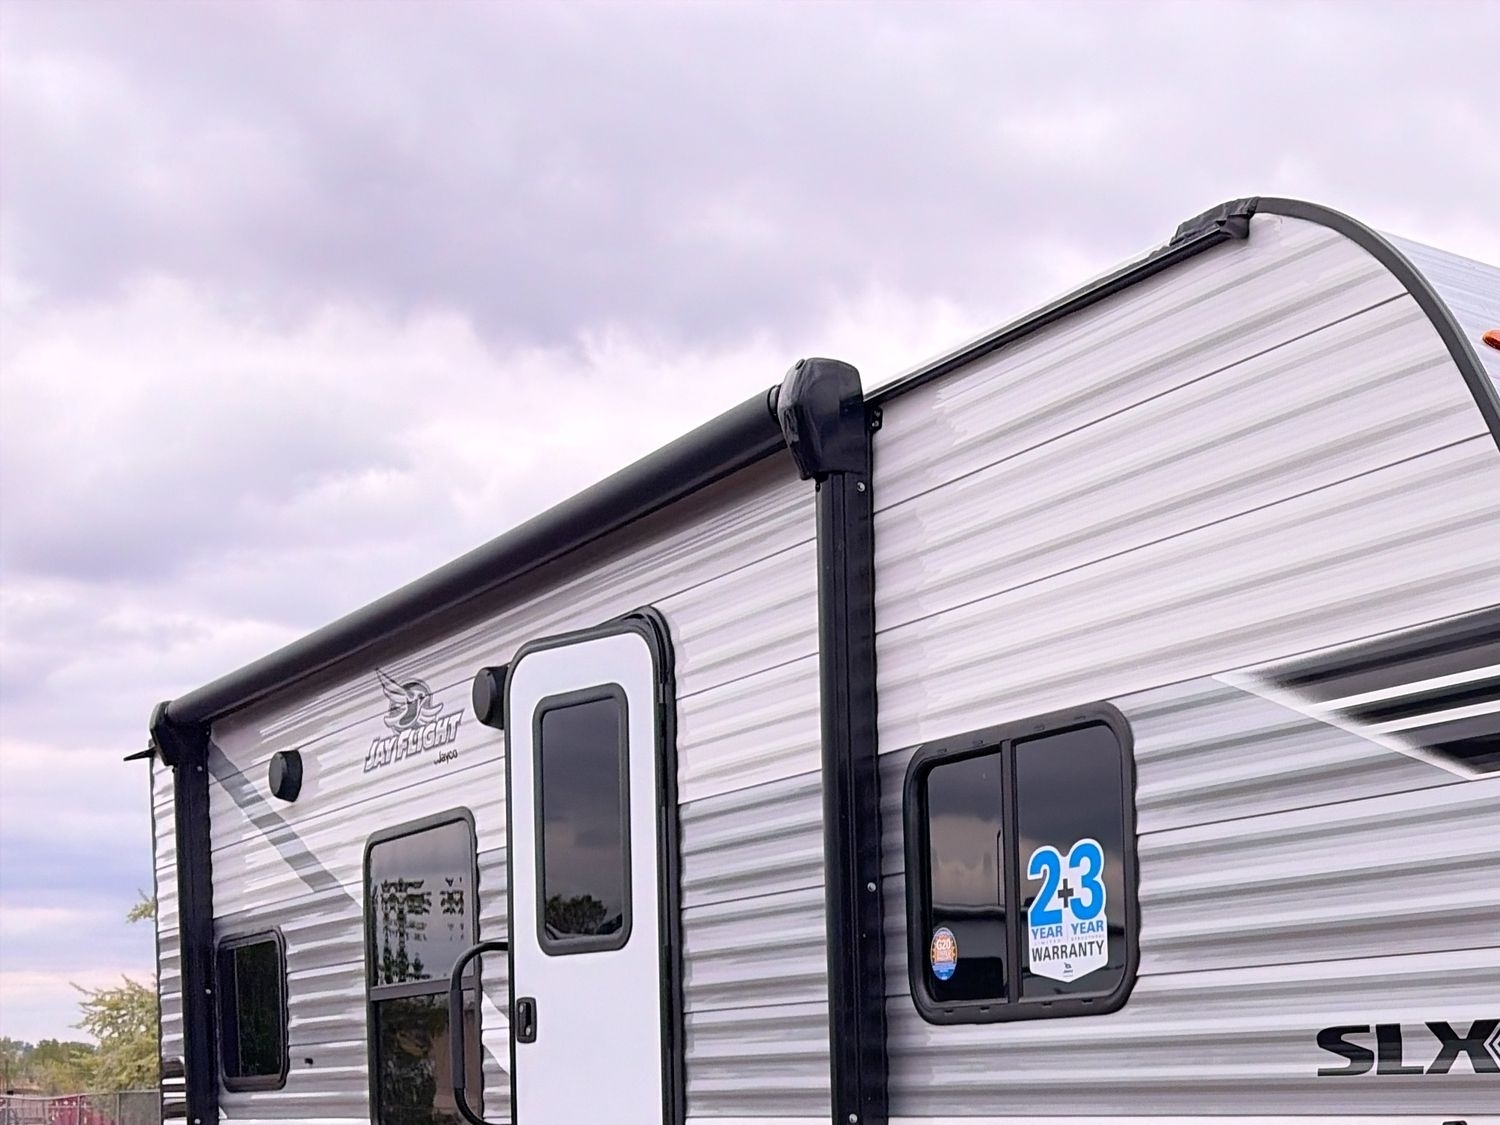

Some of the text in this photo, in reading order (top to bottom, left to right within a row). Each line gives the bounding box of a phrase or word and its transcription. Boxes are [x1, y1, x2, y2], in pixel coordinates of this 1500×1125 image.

[1031, 920, 1104, 940] YEAR YEAR
[1031, 940, 1105, 962] WARRANTY
